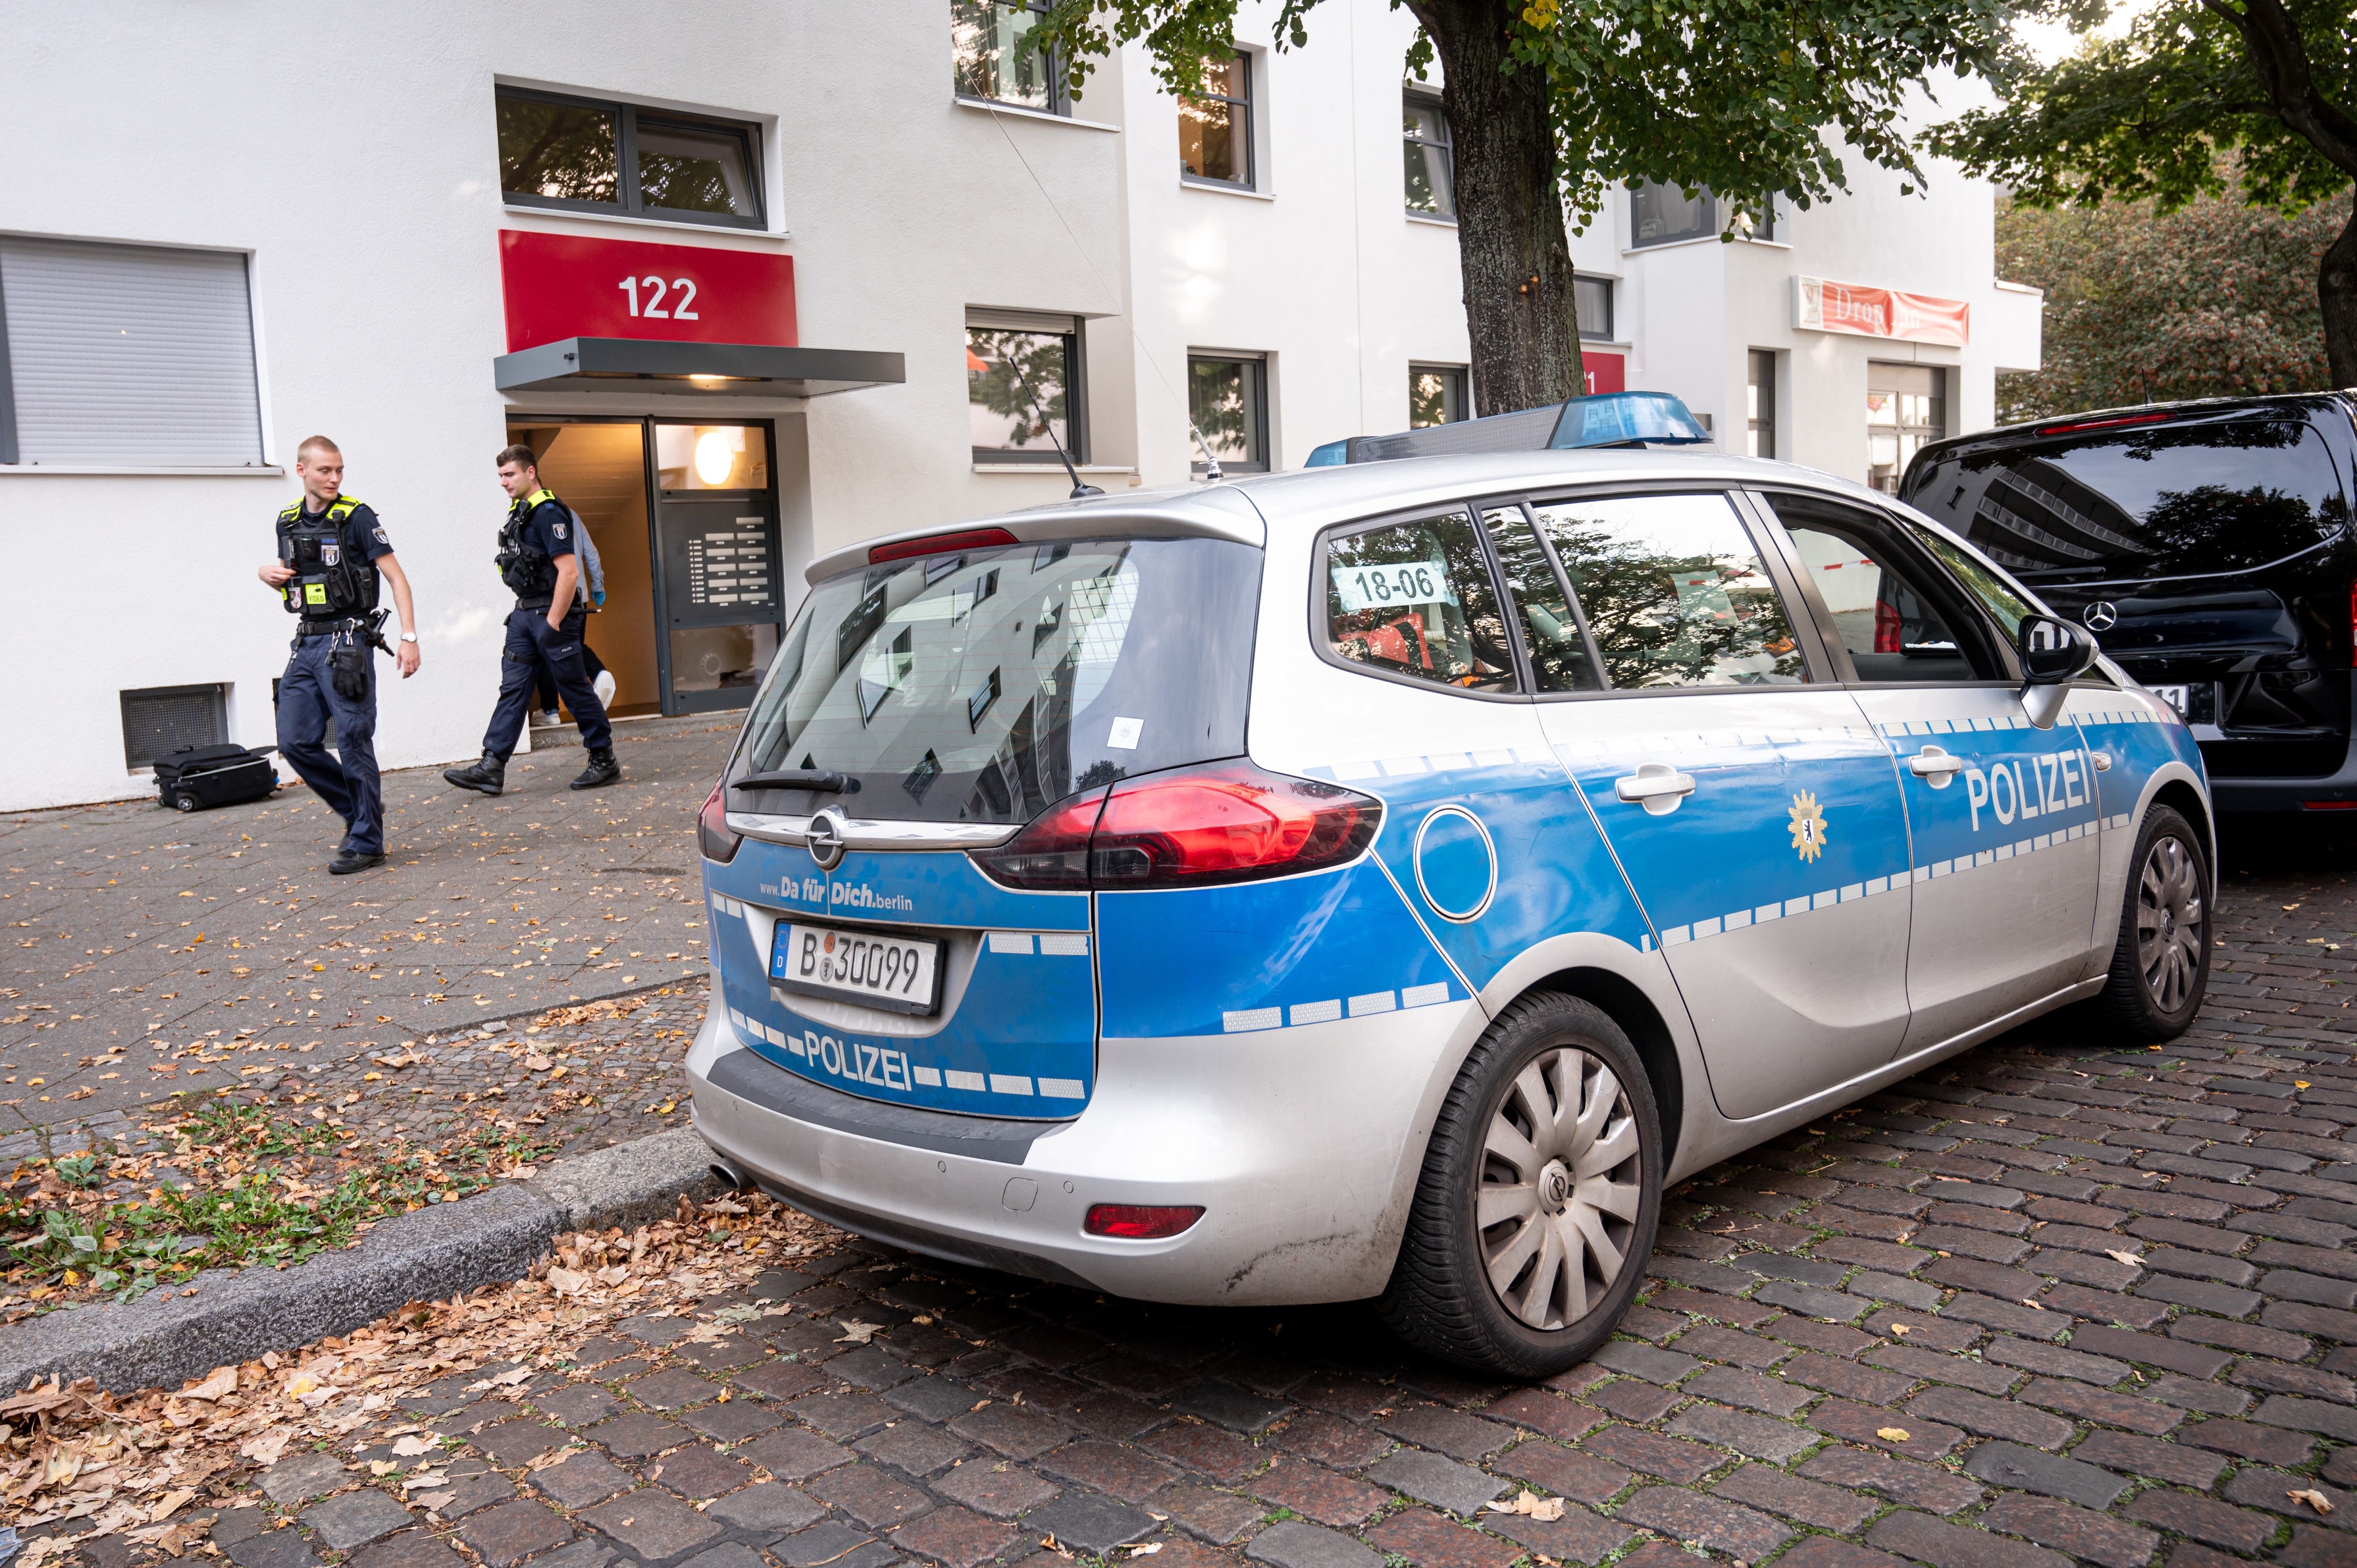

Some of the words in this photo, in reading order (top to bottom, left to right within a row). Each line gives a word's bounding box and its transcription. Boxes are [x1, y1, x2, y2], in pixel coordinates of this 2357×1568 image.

[618, 276, 699, 320] 122
[1835, 287, 1885, 335] Drop
[1584, 371, 1595, 394] 1
[1355, 568, 1434, 601] 18-06
[1965, 748, 2090, 832] POLIZEI
[803, 878, 825, 902] für
[777, 955, 783, 968] D
[800, 933, 817, 976] B
[834, 938, 919, 993] 30099
[804, 1030, 912, 1092] POLIZEI
